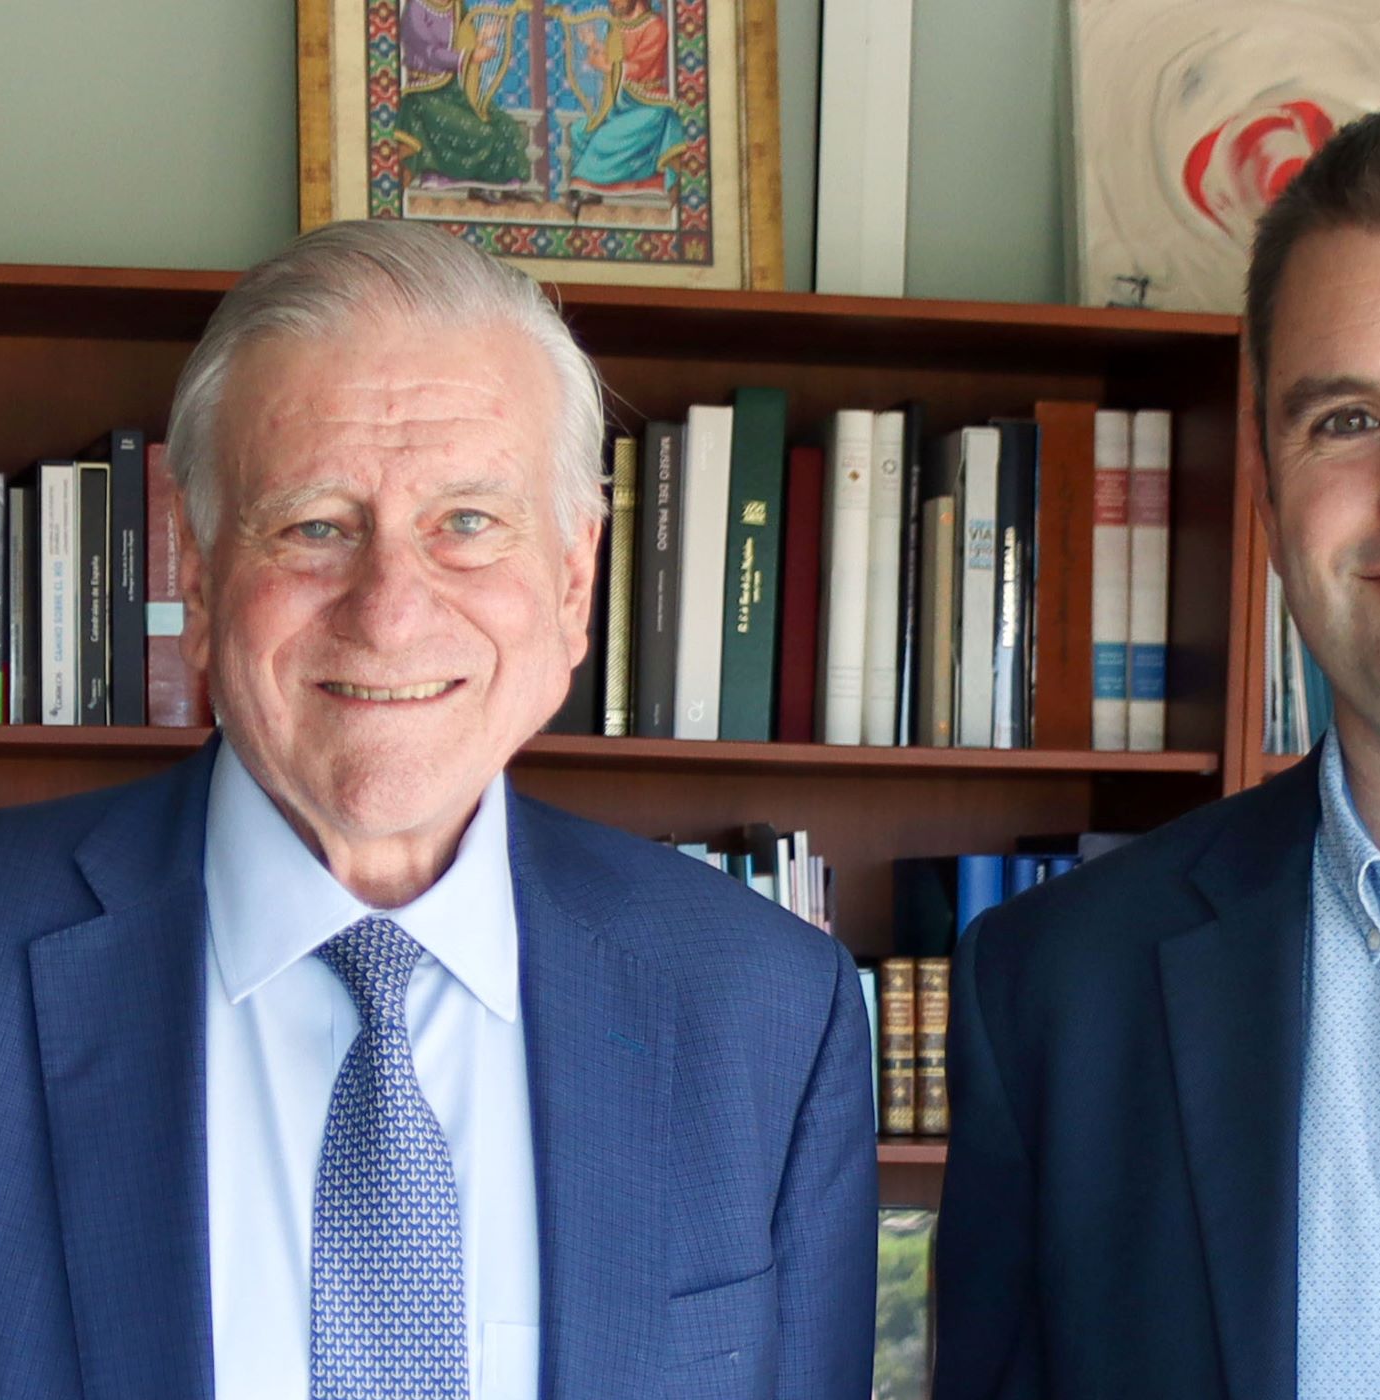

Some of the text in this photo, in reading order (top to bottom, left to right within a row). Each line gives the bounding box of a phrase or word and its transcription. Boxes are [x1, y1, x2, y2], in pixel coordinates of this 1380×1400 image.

[656, 435, 671, 550] MUSEO DEL PRADO
[90, 554, 100, 642] Catedrales de España
